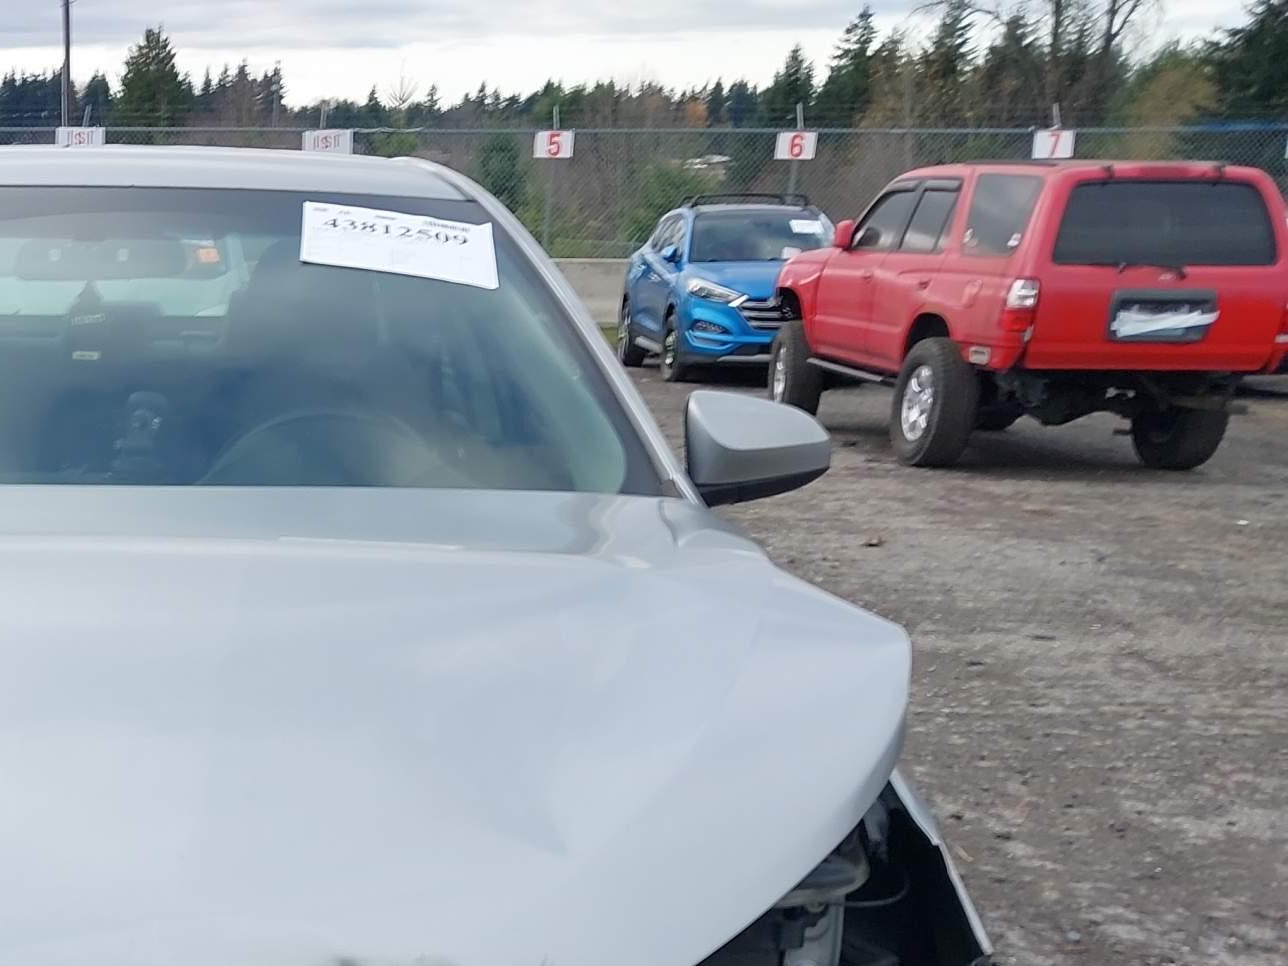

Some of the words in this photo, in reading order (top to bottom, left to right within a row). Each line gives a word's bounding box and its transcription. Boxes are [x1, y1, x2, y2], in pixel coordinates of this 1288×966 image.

[547, 132, 561, 156] 5
[790, 133, 804, 158] 6
[1048, 131, 1062, 157] 7
[321, 217, 470, 246] 43812509
